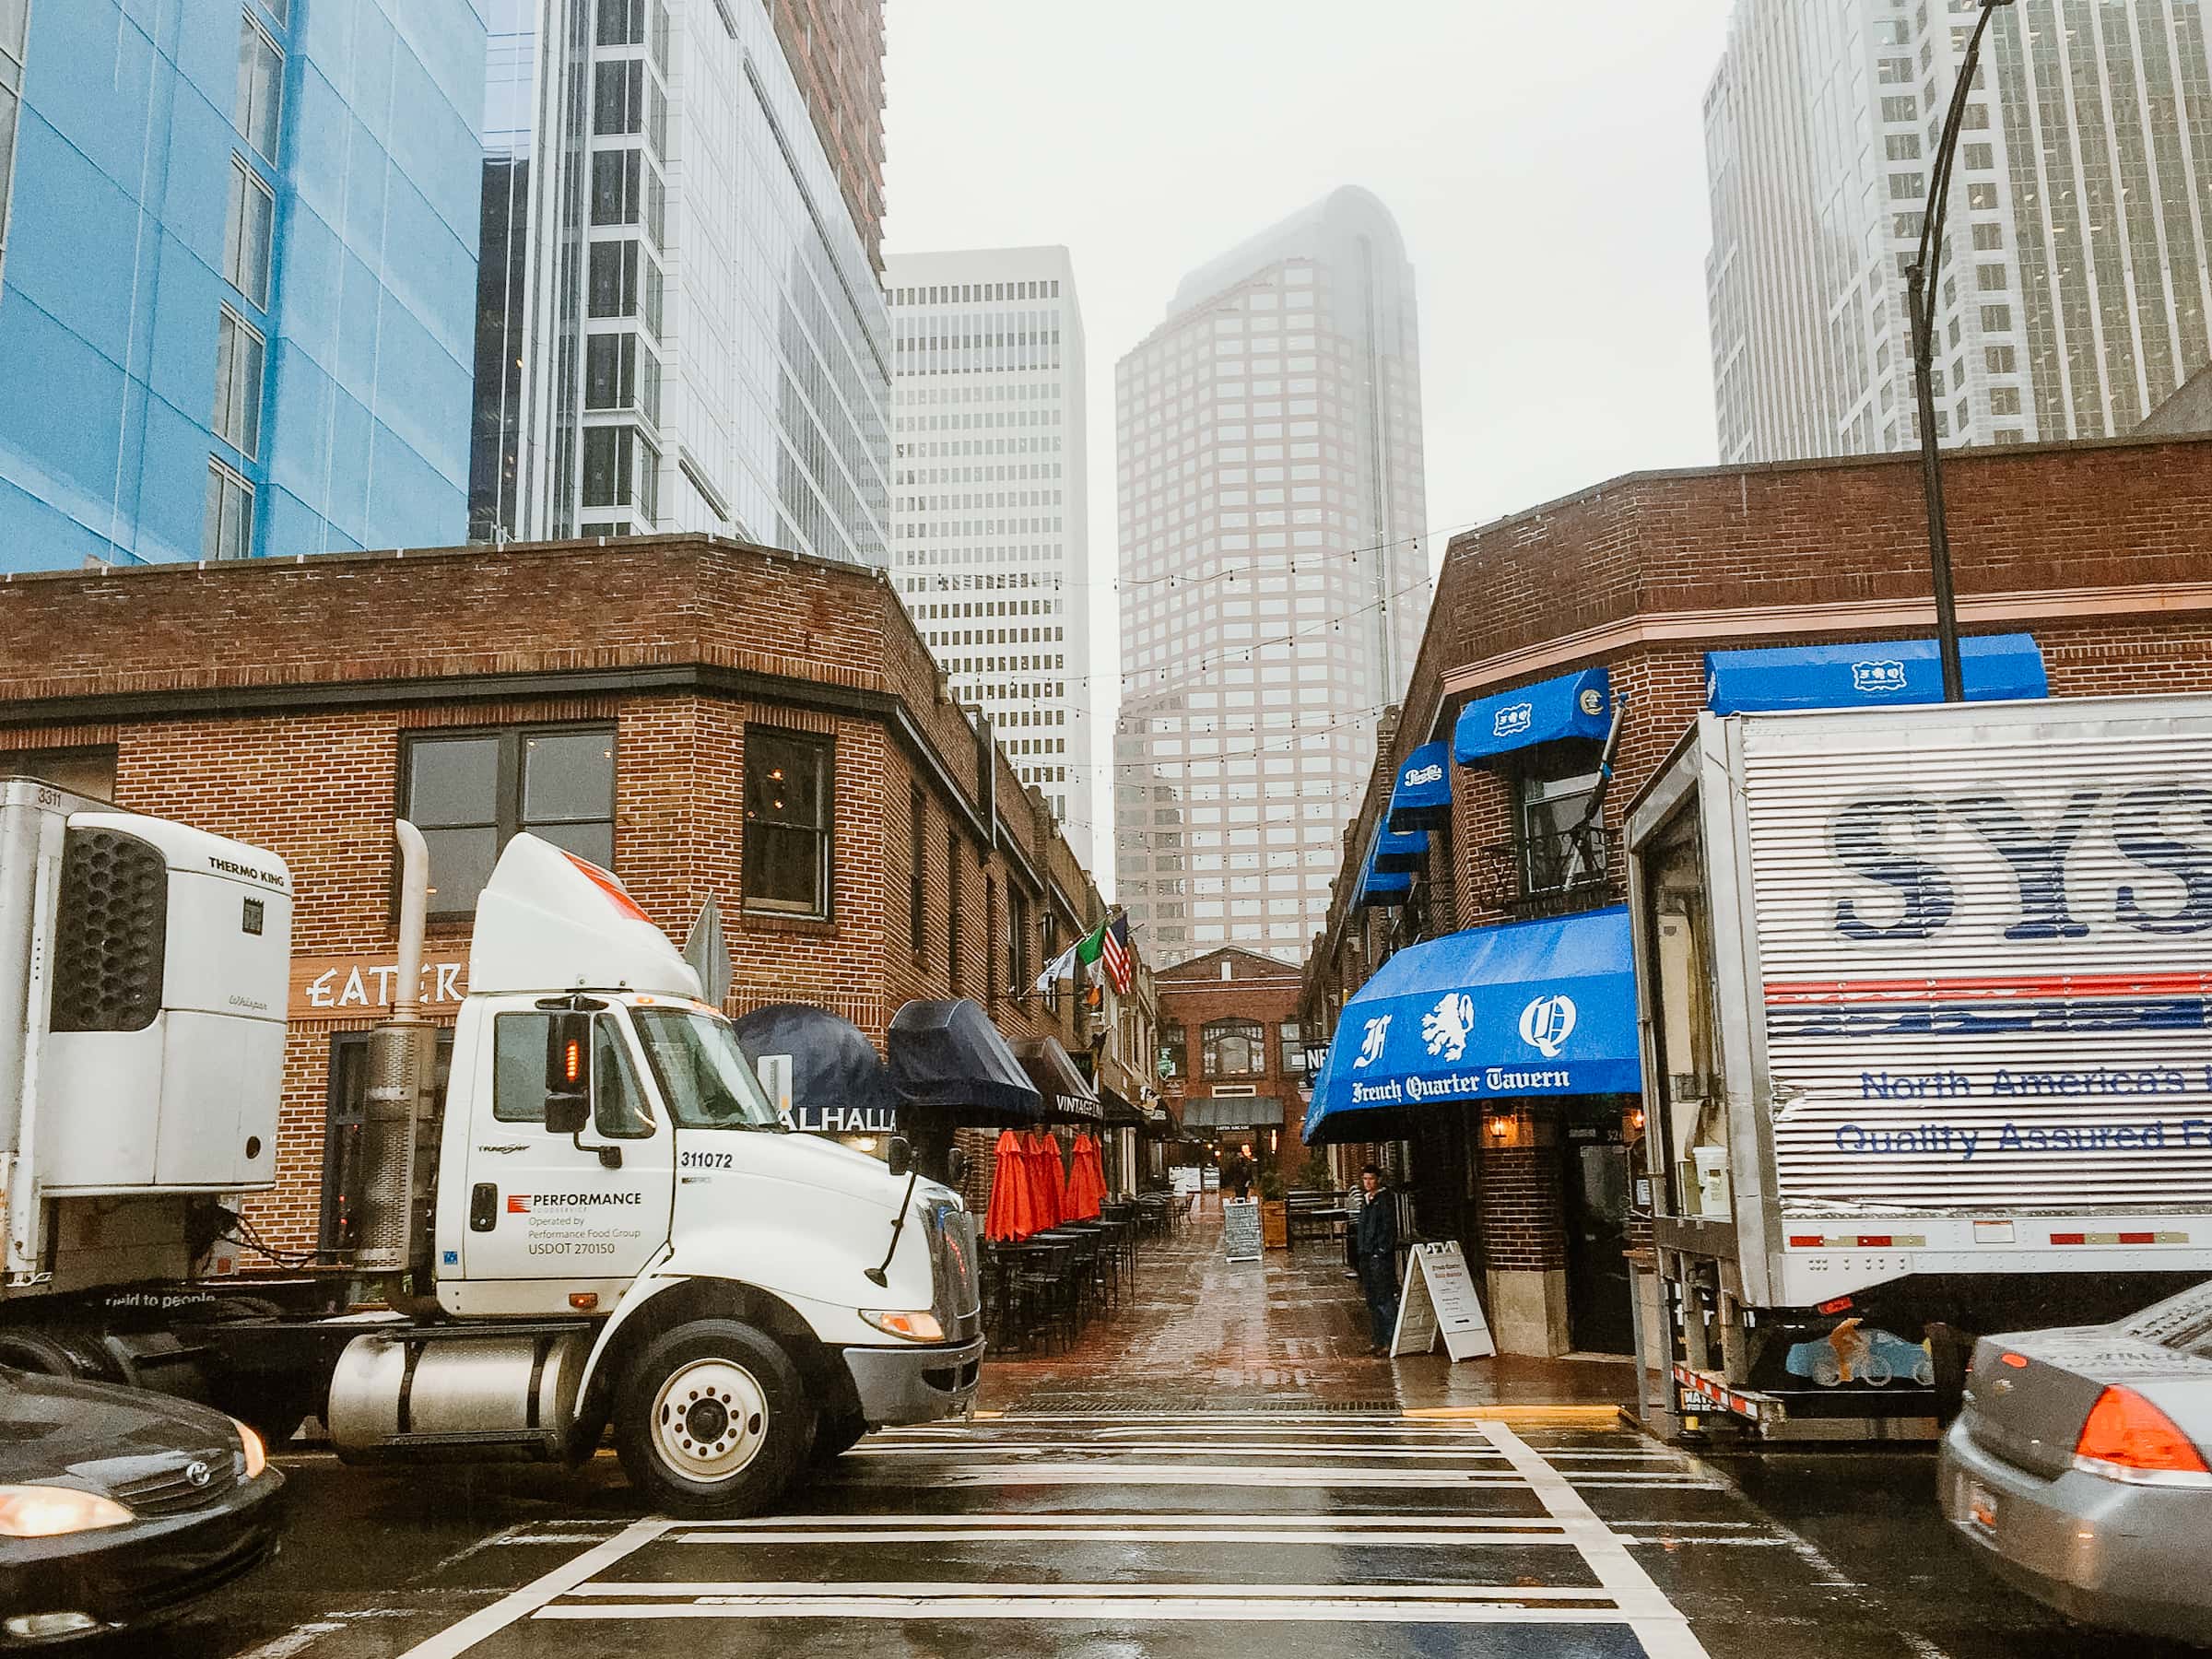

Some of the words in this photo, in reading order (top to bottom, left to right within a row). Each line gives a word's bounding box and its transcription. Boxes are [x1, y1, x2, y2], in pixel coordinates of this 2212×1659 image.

[38, 788, 61, 807] 3311
[208, 856, 257, 878] THERMO
[261, 871, 285, 887] KING
[1518, 994, 1577, 1058] Q
[1352, 1081, 1402, 1103] French
[1406, 1073, 1480, 1100] Quarter
[1486, 1067, 1571, 1090] Tavern
[1861, 1071, 1971, 1100] North
[1991, 1065, 2185, 1097] America's
[1836, 1124, 1979, 1161] Quality
[1999, 1120, 2165, 1151] Assured
[681, 1152, 734, 1169] 311072
[533, 1193, 641, 1206] PERFORMANCE
[529, 1217, 571, 1227] Operated
[574, 1216, 584, 1227] by
[529, 1230, 585, 1239] Performance
[588, 1230, 610, 1238] Food
[612, 1229, 641, 1240] Group
[529, 1243, 571, 1254] USDOT
[575, 1243, 615, 1254] 270150
